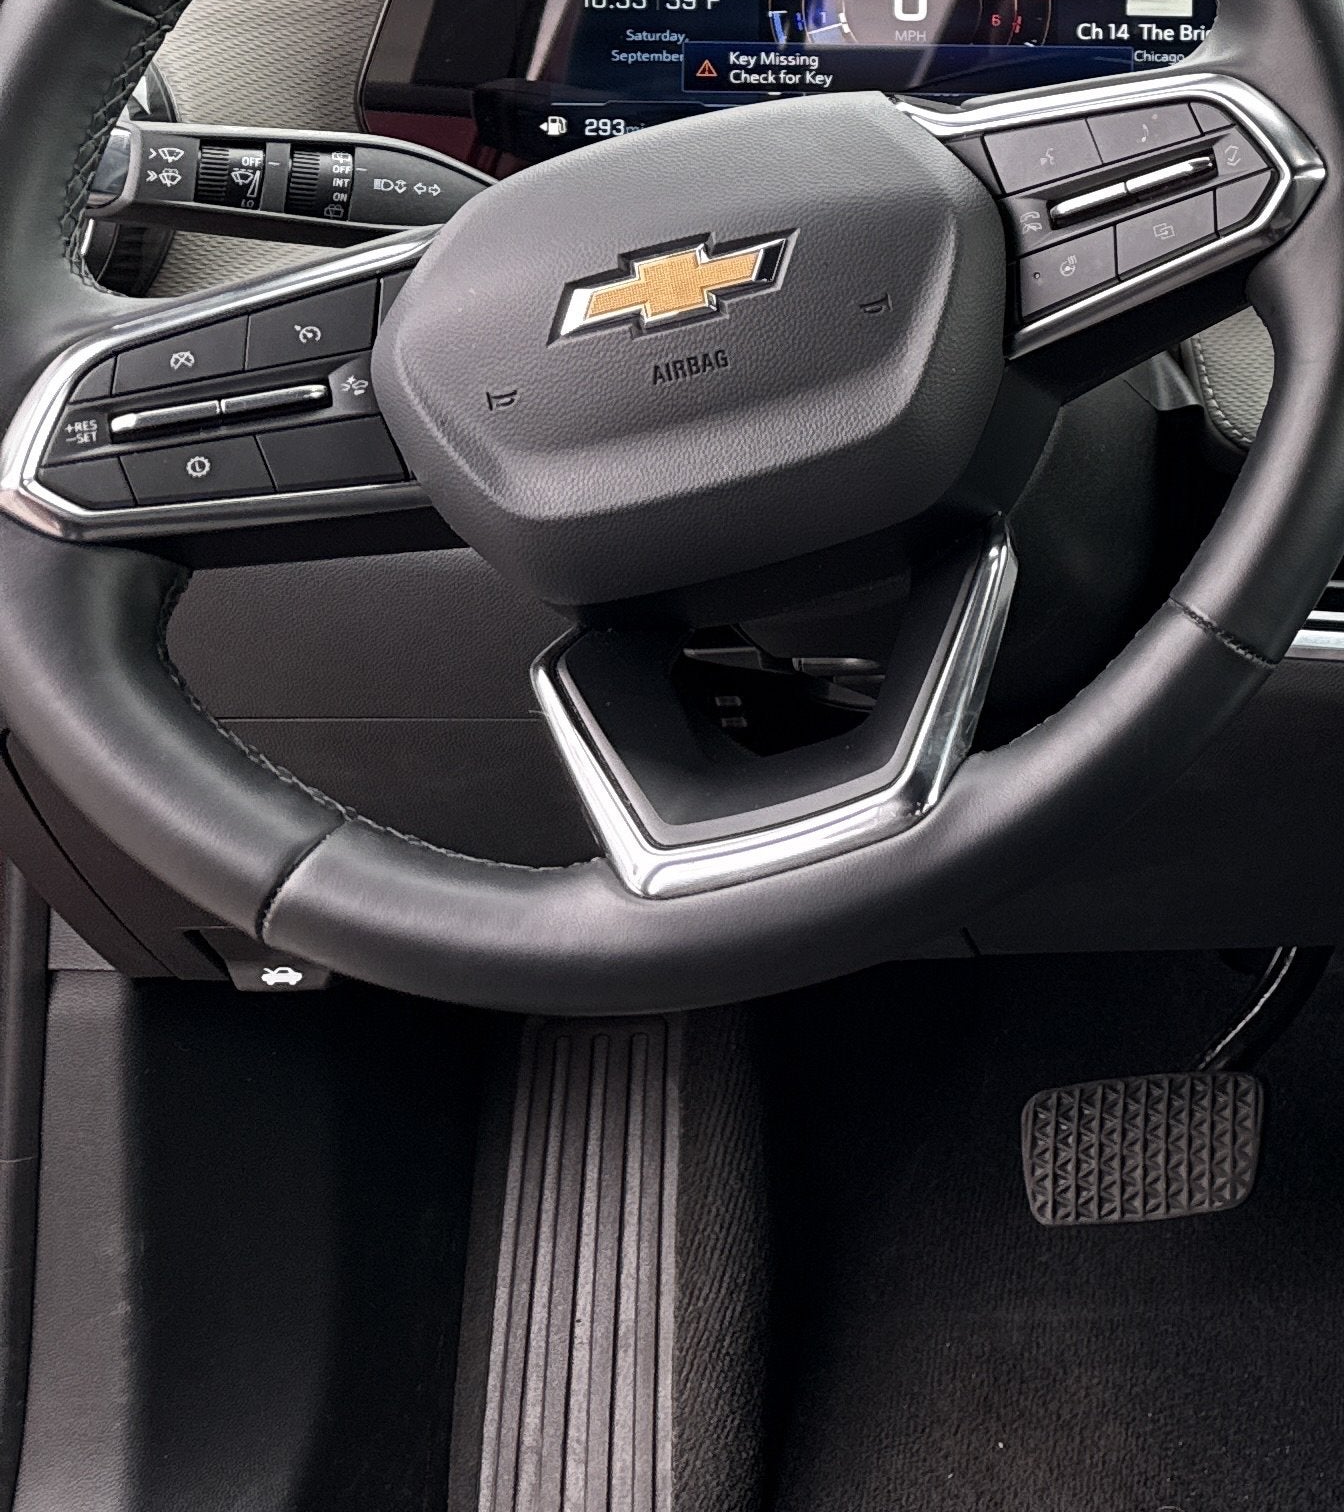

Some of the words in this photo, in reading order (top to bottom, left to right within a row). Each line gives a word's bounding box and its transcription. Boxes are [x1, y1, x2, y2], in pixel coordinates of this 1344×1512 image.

[626, 29, 689, 44] Saturday,
[895, 29, 927, 42] MPH
[1077, 23, 1104, 40] Ch
[1108, 23, 1130, 41] 14
[1138, 24, 1175, 41] The
[611, 49, 684, 65] September
[729, 52, 757, 68] Key
[760, 52, 819, 68] Missing
[1134, 50, 1185, 66] Chicago
[729, 71, 777, 85] Check
[780, 71, 802, 85] for
[805, 71, 833, 87] Key
[584, 118, 625, 136] 293
[241, 156, 262, 168] OFF
[332, 164, 352, 175] OFF
[333, 178, 349, 188] INT
[332, 193, 347, 202] ON
[652, 349, 730, 385] AIRBAG
